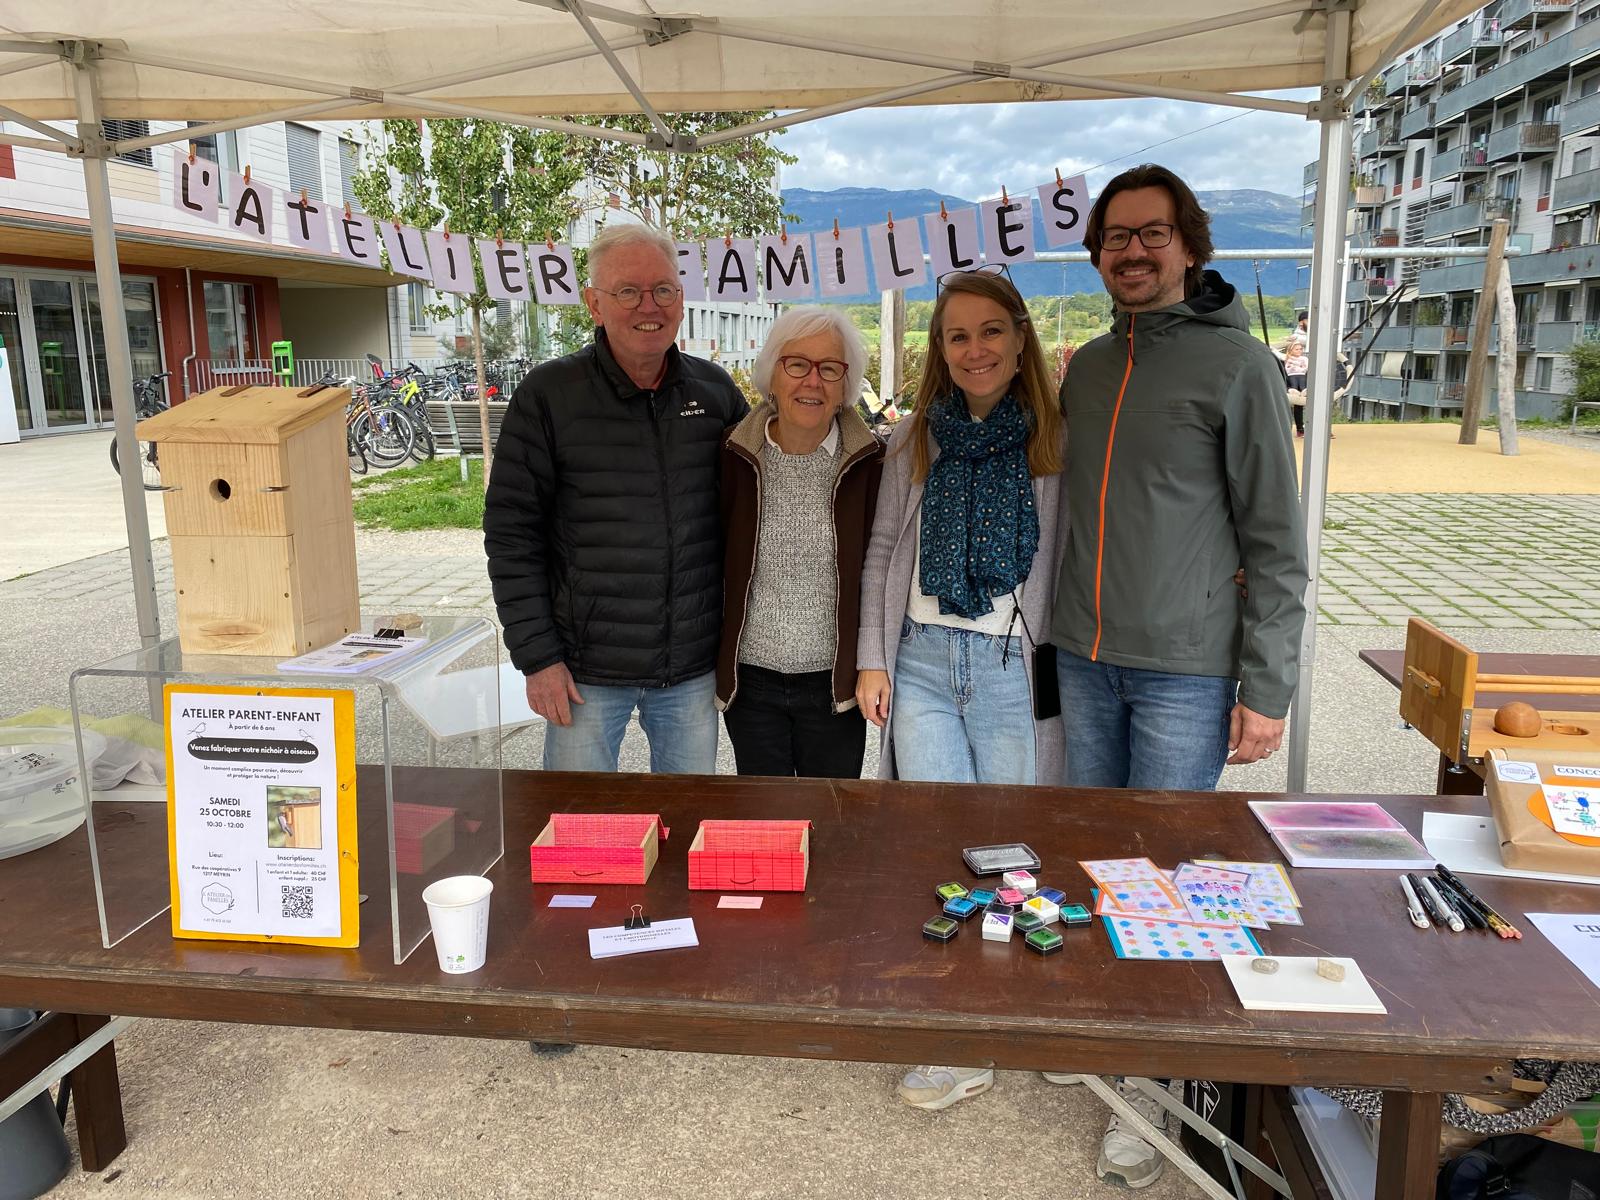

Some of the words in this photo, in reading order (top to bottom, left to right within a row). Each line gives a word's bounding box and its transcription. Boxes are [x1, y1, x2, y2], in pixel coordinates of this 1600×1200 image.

[181, 162, 572, 295] L'ATELIER
[678, 188, 1080, 294] AMILLES
[182, 708, 225, 719] ATELIER
[228, 710, 321, 722] PARENT-ENFANT
[190, 744, 210, 752] Venez
[210, 744, 241, 754] fabriquer
[260, 746, 282, 754] nichoir
[210, 796, 240, 806] SAMEDI
[200, 808, 210, 816] 25
[212, 808, 252, 818] OCTOBRE
[277, 854, 316, 862] Inscriptions:
